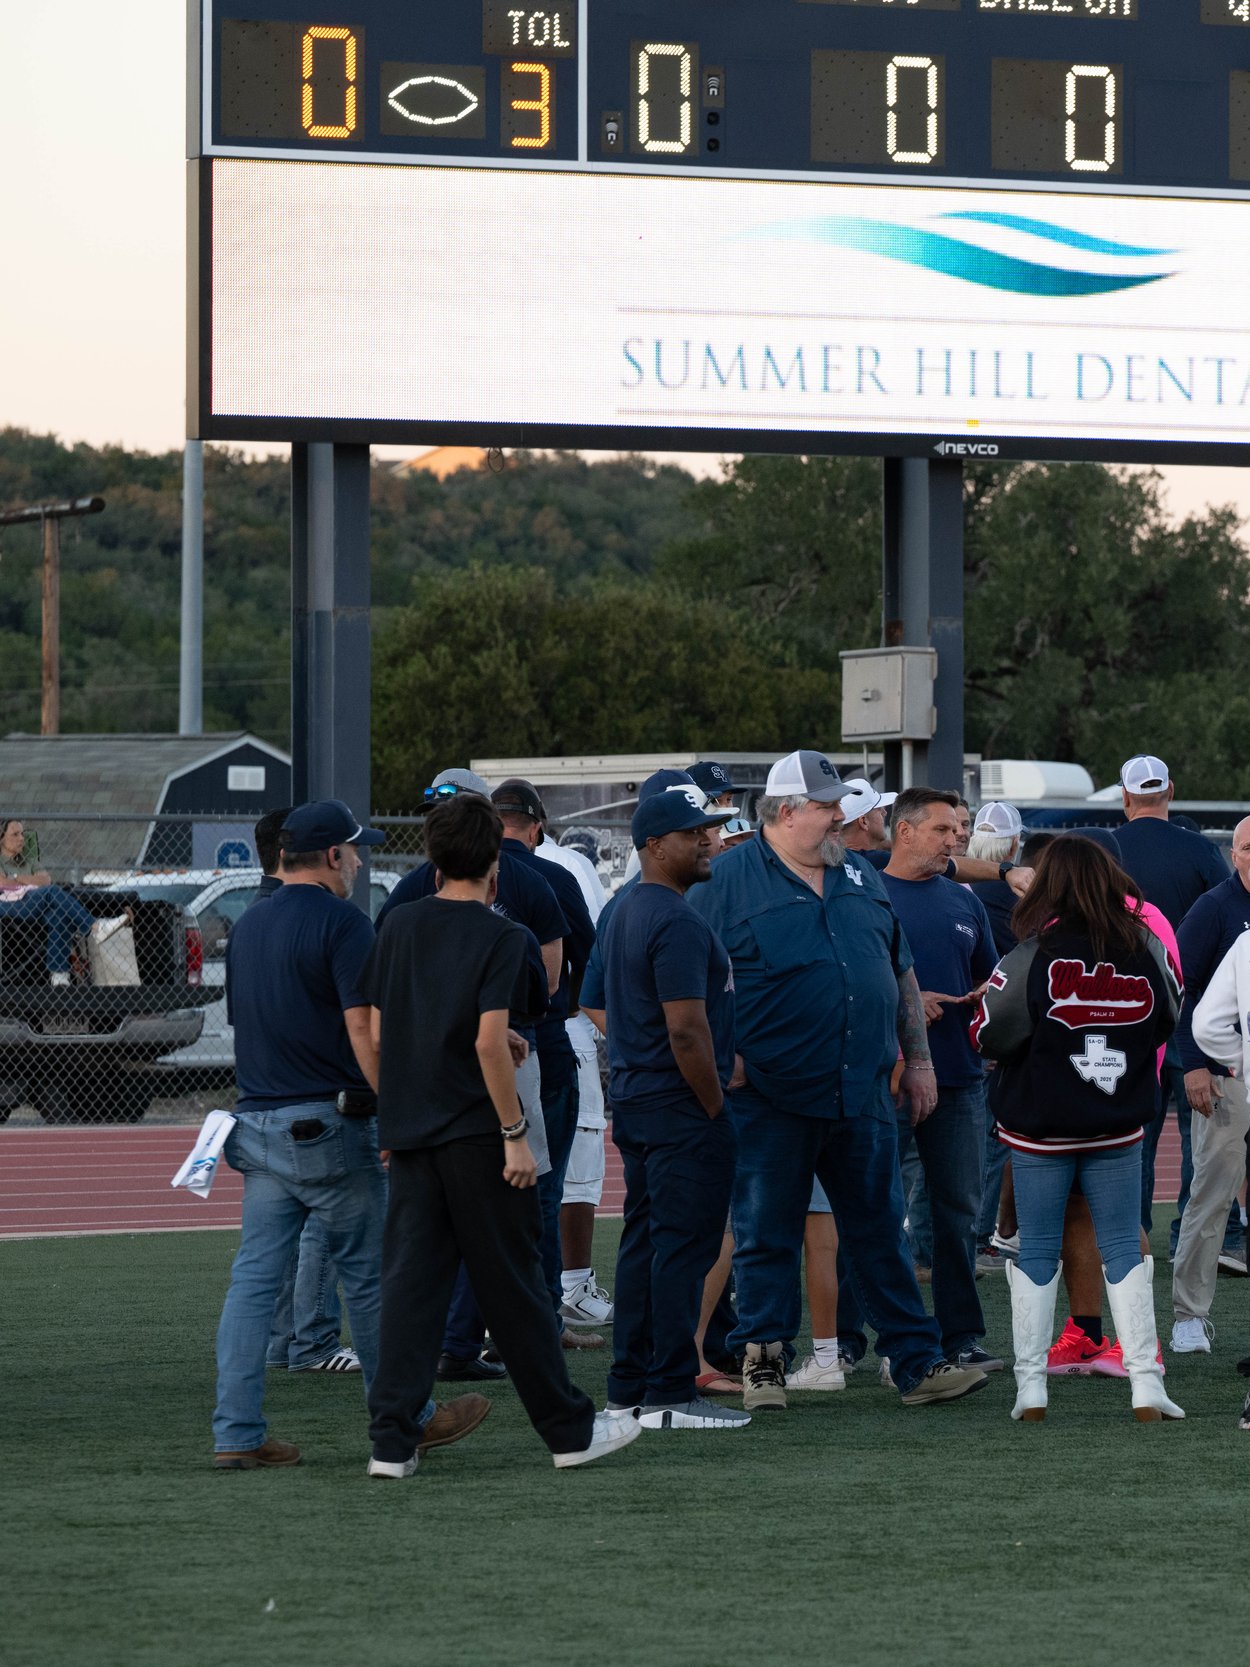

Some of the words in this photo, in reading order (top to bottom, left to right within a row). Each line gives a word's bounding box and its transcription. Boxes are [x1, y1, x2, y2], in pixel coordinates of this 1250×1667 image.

[507, 10, 570, 47] TOL
[301, 26, 357, 138] 0
[511, 62, 550, 148] 3
[638, 43, 691, 153] 0
[886, 55, 938, 164] 0
[1065, 64, 1116, 172] 0
[620, 336, 892, 395] SUMMER
[915, 347, 1049, 400] HILL
[945, 443, 999, 455] NEVCO
[1050, 960, 1150, 1002] Wallace
